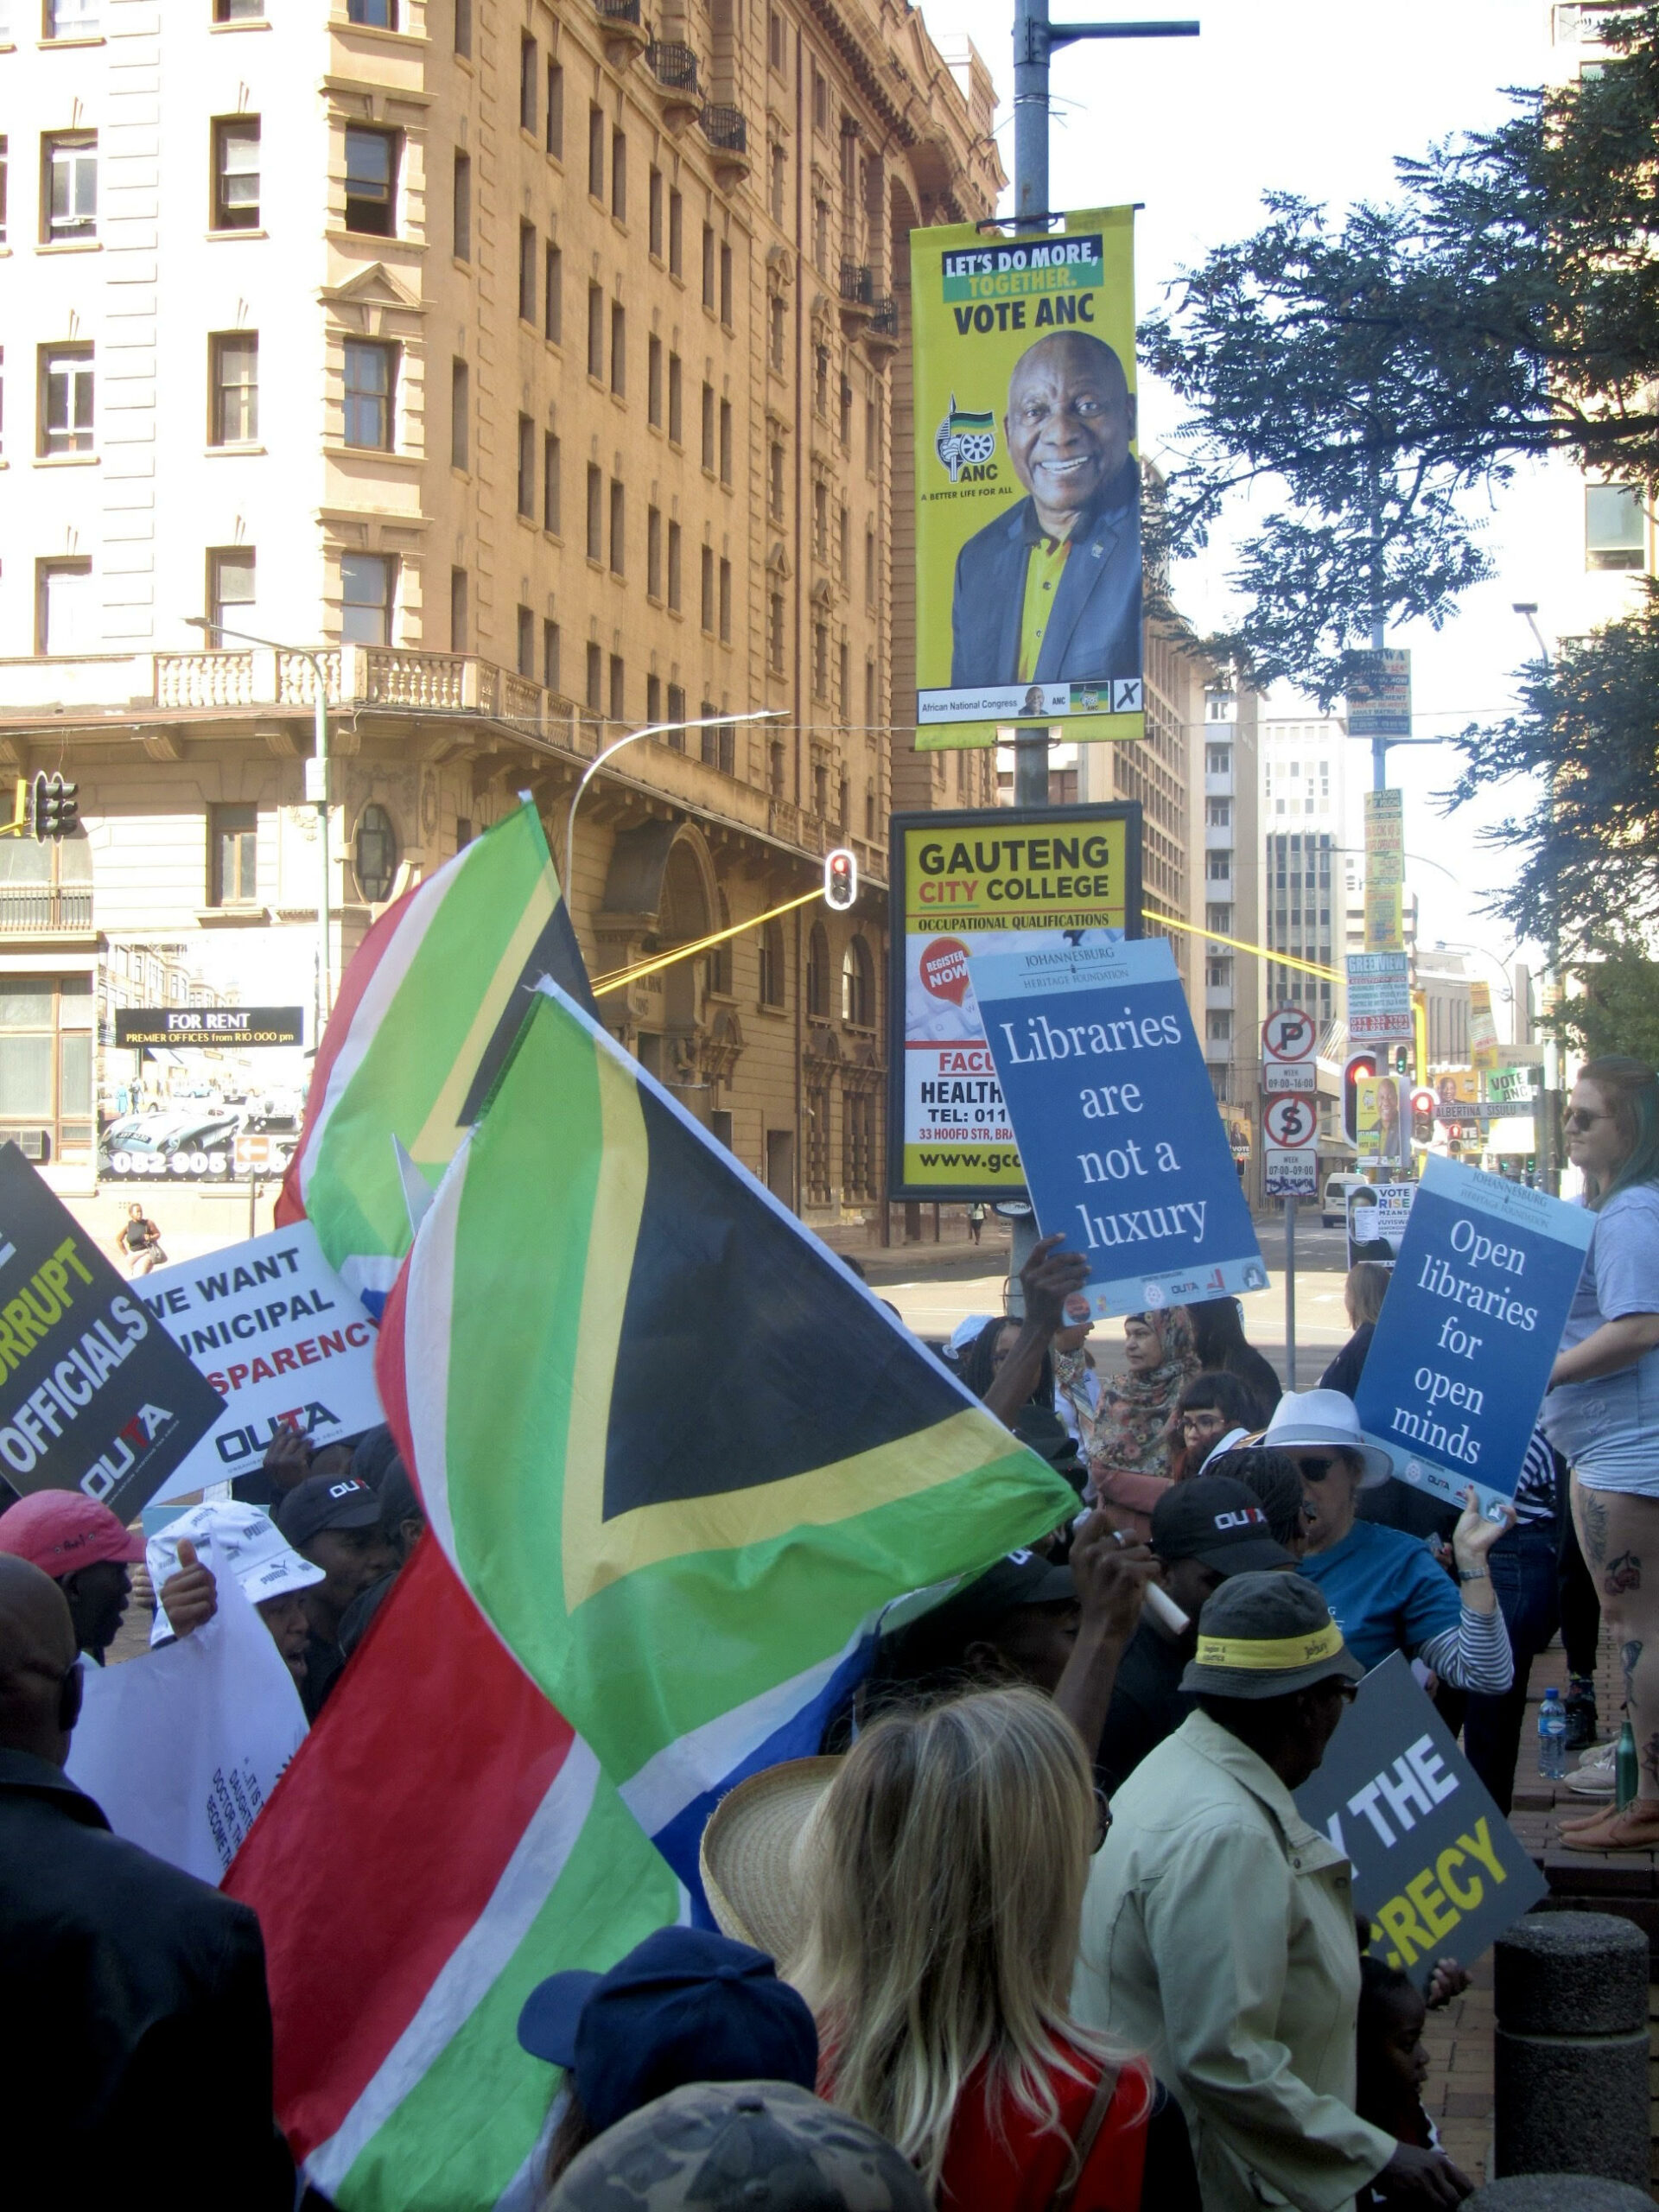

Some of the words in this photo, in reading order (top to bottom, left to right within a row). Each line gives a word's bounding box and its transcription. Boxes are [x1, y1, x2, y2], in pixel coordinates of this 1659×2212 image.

[945, 251, 993, 278] LET'S
[998, 250, 1027, 273] DO
[1031, 242, 1099, 268] MORE,
[969, 267, 1077, 297] TOGETHER.
[954, 301, 1027, 335] VOTE
[1034, 293, 1094, 328] ANC
[960, 464, 999, 483] ANC
[930, 492, 957, 500] BETTER
[922, 702, 948, 712] African
[950, 700, 980, 711] National
[982, 698, 1018, 710] Congress
[1052, 697, 1066, 706] ANC
[918, 836, 1109, 875] GAUTENG
[919, 880, 979, 903] CITY
[987, 874, 1109, 901] COLLEGE
[918, 916, 1007, 931] OCCUPATIONAL
[1013, 913, 1109, 929] QUALIFICATIONS
[926, 950, 965, 972] REGISTER
[1025, 947, 1115, 969] JOHANNESBURG
[929, 963, 968, 988] NOW
[1024, 973, 1070, 988] HERITAGE
[1072, 968, 1129, 984] FOUNDATION
[168, 1014, 201, 1029] FOR
[207, 1013, 251, 1028] RENT
[126, 1033, 167, 1043] PREMIER
[170, 1033, 209, 1042] OFFICES
[212, 1033, 232, 1042] from
[279, 1033, 294, 1044] pm
[1000, 1007, 1181, 1065] Libraries
[1281, 1023, 1303, 1050] P
[921, 1082, 1003, 1103] HEALTH
[1268, 1078, 1313, 1088] 09:00-16:00
[1491, 1072, 1522, 1090] VOTE
[1503, 1086, 1528, 1102] ANC
[1080, 1083, 1144, 1119] are
[1436, 1105, 1481, 1117] ALBERTINA
[1487, 1104, 1516, 1116] SISULU
[928, 1109, 968, 1122] TEL:
[975, 1109, 1006, 1122] 011
[1281, 1107, 1302, 1135] S
[919, 1128, 931, 1140] 33
[934, 1128, 968, 1140] HOOFD
[971, 1128, 993, 1141] STR,
[113, 1152, 167, 1173] 082
[172, 1152, 227, 1173] 905
[1077, 1140, 1148, 1184] not
[1155, 1142, 1181, 1173] a
[1269, 1166, 1313, 1175] 07:00-09:00
[1472, 1172, 1548, 1207] JOHANNESBURG
[1379, 1198, 1410, 1209] RISE
[1076, 1200, 1207, 1249] luxury
[1450, 1220, 1526, 1276] Open
[143, 1287, 191, 1319] WE
[195, 1248, 299, 1302] WANT
[1171, 1281, 1199, 1294] OUTA
[1417, 1254, 1539, 1332] libraries
[0, 1236, 94, 1382] RRUPT
[179, 1289, 334, 1357] UNICIPAL
[1437, 1316, 1483, 1360] for
[0, 1295, 149, 1472] OFFICIALS
[1414, 1367, 1484, 1416] open
[215, 1401, 341, 1464] OUTA
[1390, 1407, 1481, 1465] minds
[79, 1403, 174, 1501] OUTA
[1213, 1507, 1268, 1530] OUTA
[1347, 1732, 1460, 1848] THE
